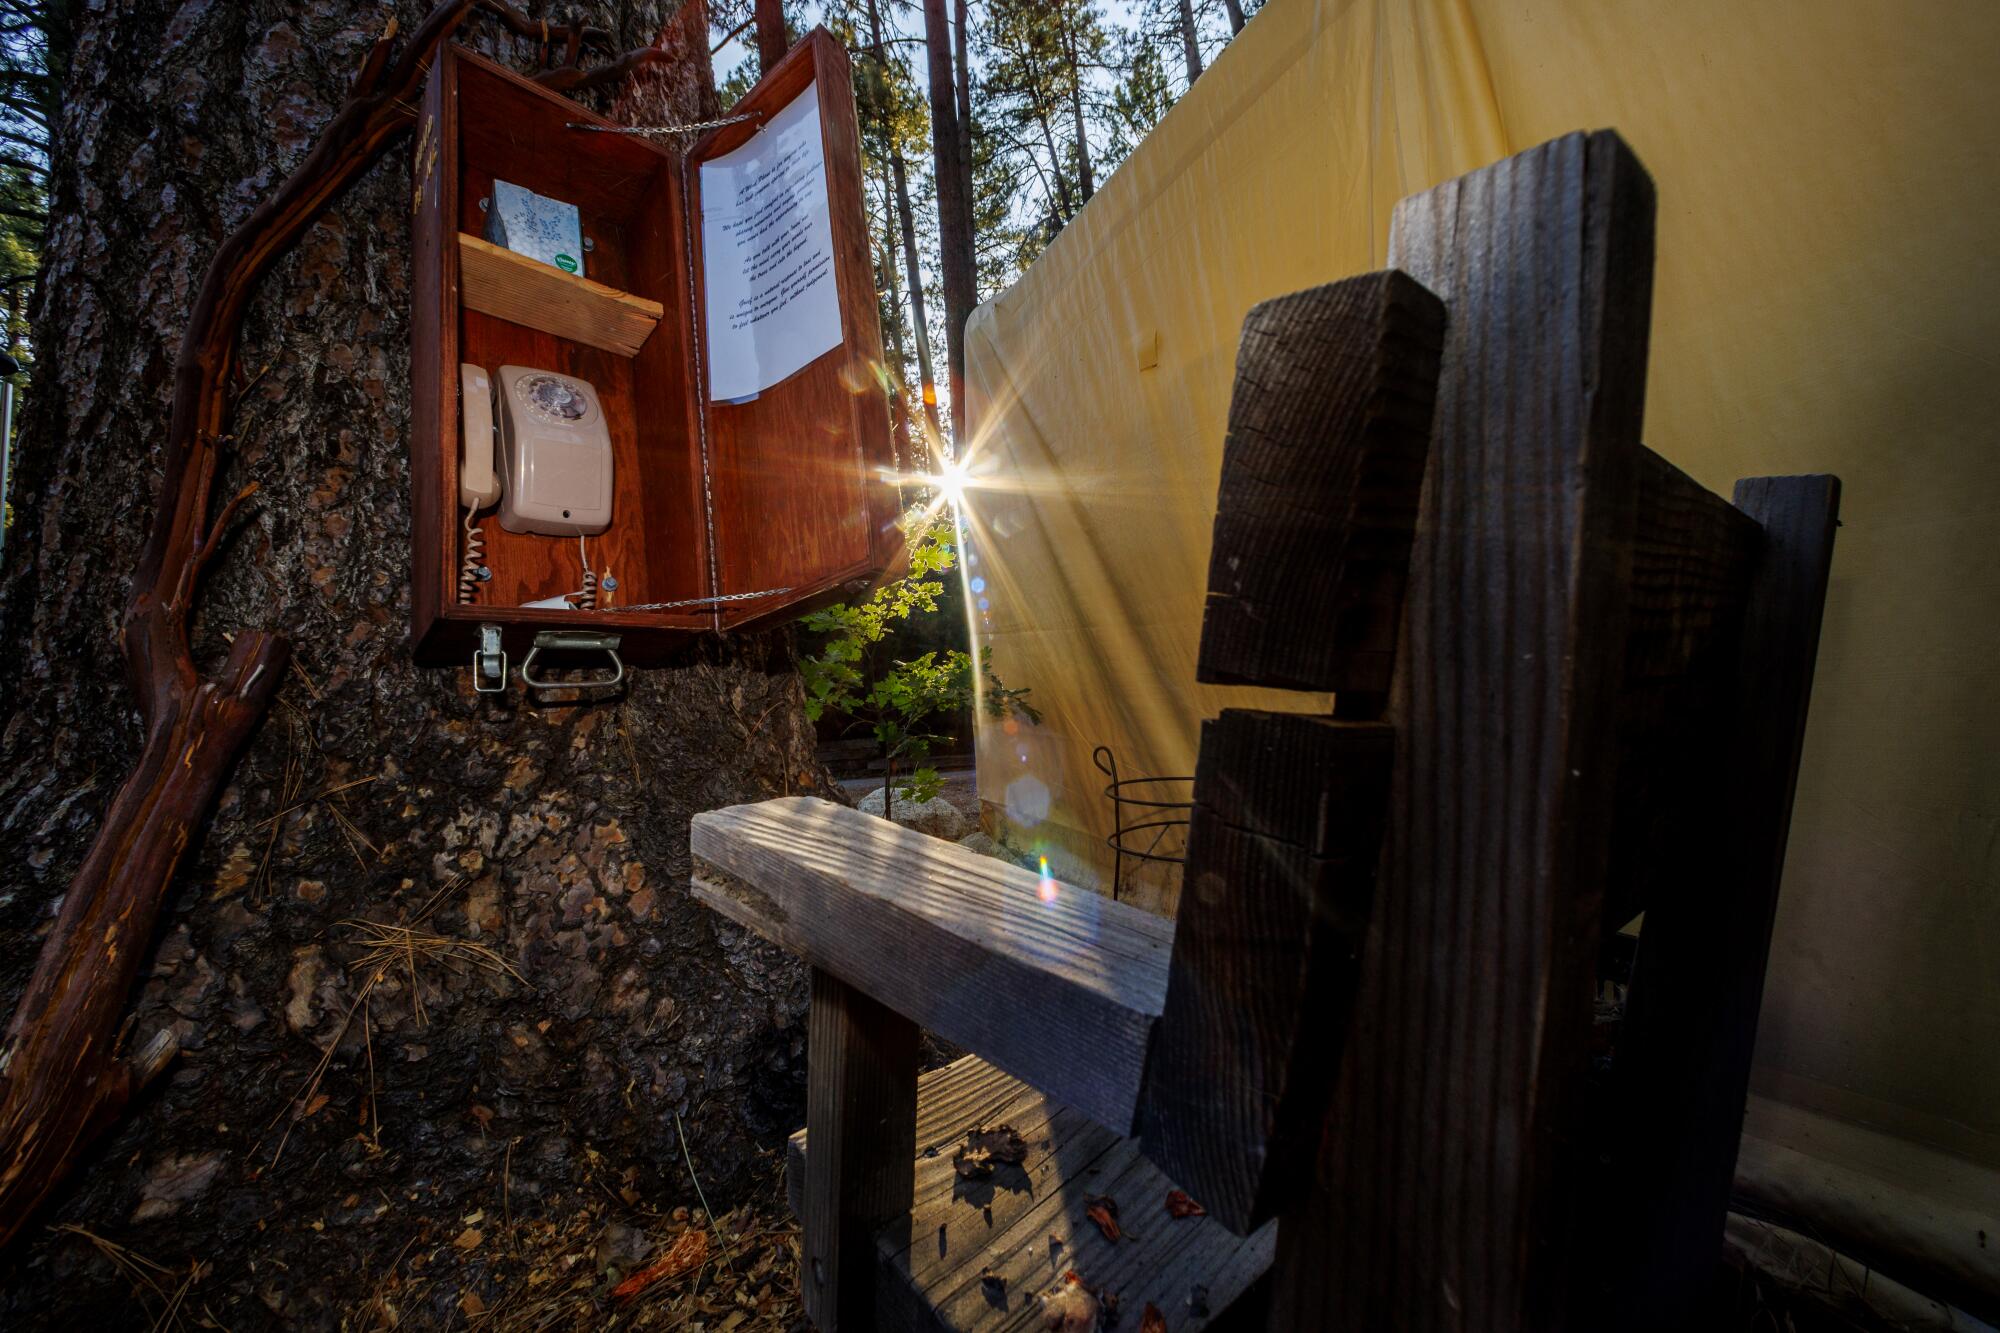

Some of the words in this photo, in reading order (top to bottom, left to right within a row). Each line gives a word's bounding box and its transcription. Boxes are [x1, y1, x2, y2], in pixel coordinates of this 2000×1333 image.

[758, 171, 770, 182] Phone
[745, 193, 753, 202] lost
[753, 207, 763, 219] find
[773, 203, 782, 213] and
[737, 240, 746, 248] you
[759, 225, 768, 235] had
[771, 235, 780, 248] with
[759, 256, 770, 267] wind
[770, 249, 781, 260] carry
[782, 240, 791, 251] your
[764, 280, 780, 295] natural
[812, 248, 822, 260] and
[807, 256, 831, 277] permission
[771, 305, 779, 314] you
[789, 285, 805, 301] without
